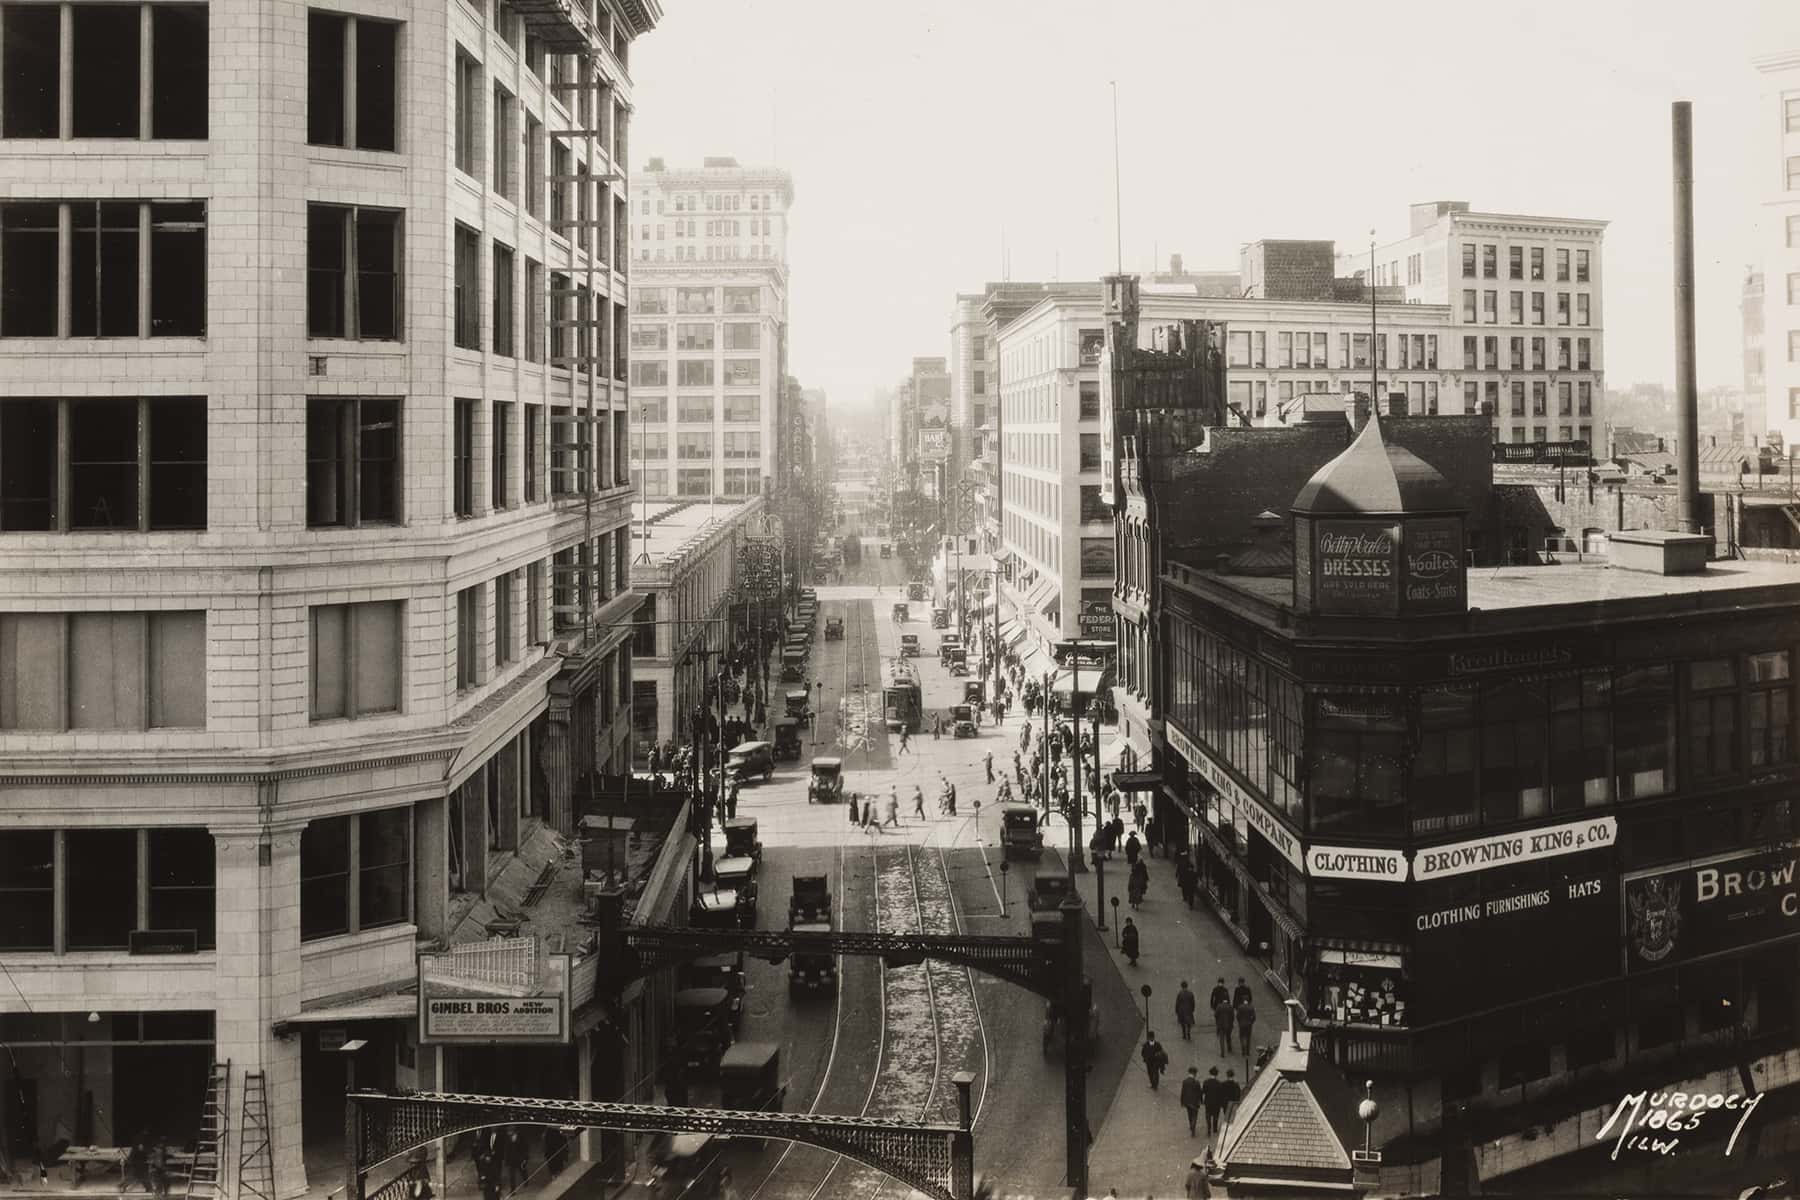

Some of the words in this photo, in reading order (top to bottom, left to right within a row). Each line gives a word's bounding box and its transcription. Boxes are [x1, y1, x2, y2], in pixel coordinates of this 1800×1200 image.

[1323, 558, 1391, 576] DRESSES
[1407, 553, 1459, 571] Wooltex
[1170, 729, 1208, 774] BROWNING
[1211, 762, 1234, 793] KING
[1243, 801, 1294, 857] COMPANY
[1423, 837, 1523, 873] BROWNING
[1530, 829, 1573, 853] KING
[1576, 833, 1585, 848] &
[1588, 824, 1610, 842] CO.
[1314, 853, 1398, 874] CLOTHING
[1416, 903, 1480, 931] CLOTHING
[1486, 889, 1550, 917] FURNISHINGS
[1568, 879, 1601, 899] HATS
[431, 1002, 474, 1014] GIMBEL
[476, 1002, 510, 1014] BROS
